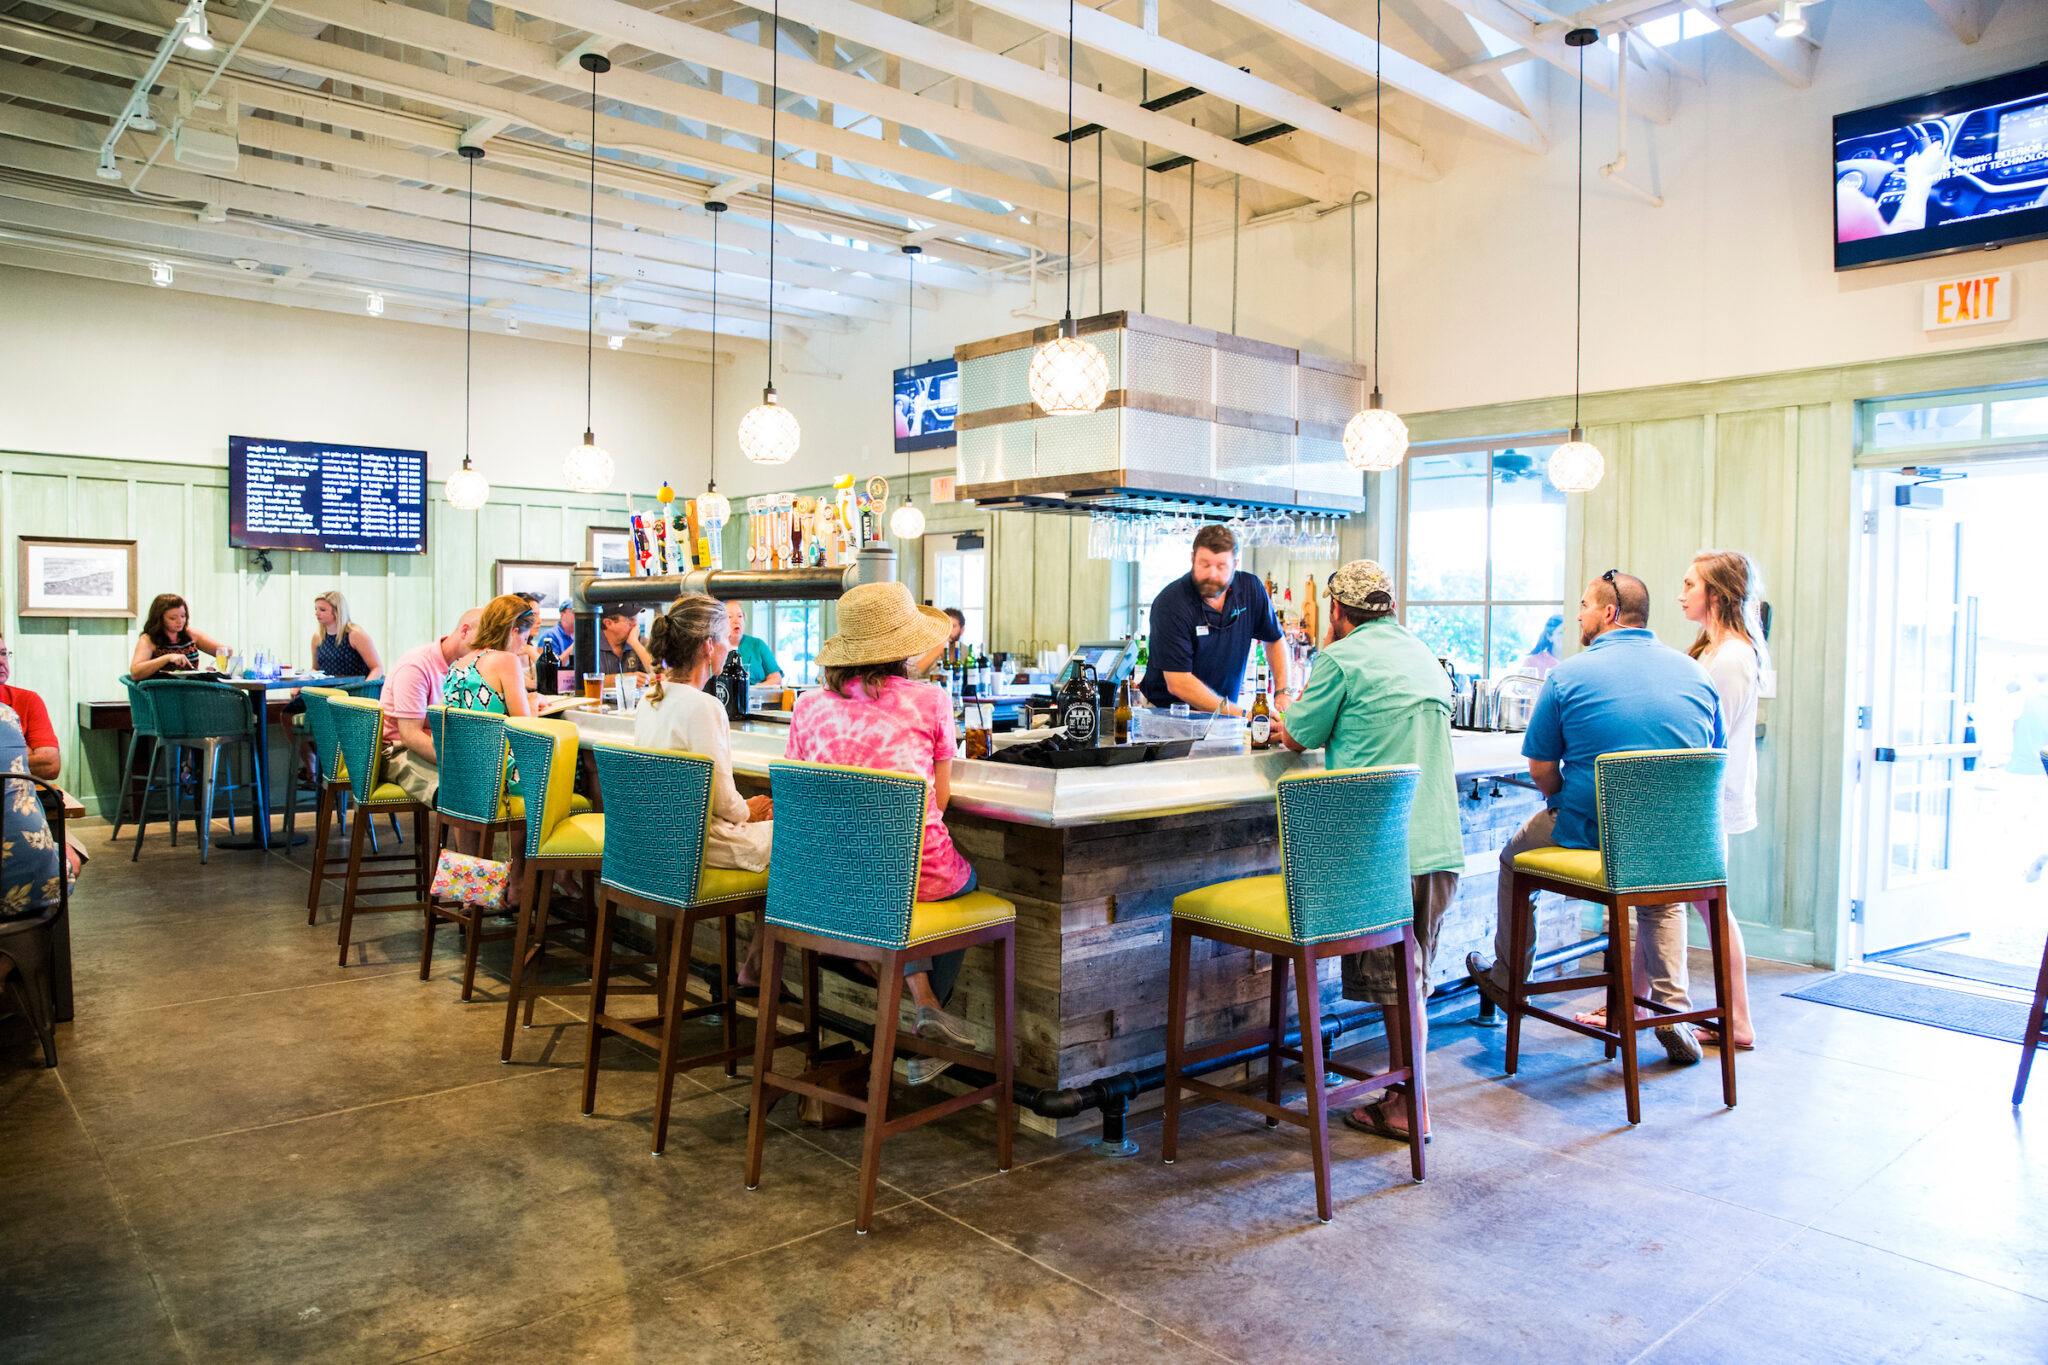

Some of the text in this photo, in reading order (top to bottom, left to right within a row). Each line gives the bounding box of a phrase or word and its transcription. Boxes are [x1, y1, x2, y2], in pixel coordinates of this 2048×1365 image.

[1995, 143, 2042, 159] INTERIOR
[1952, 163, 1988, 177] SMART
[1937, 276, 2000, 325] EXIT
[1076, 717, 1091, 726] TAP
